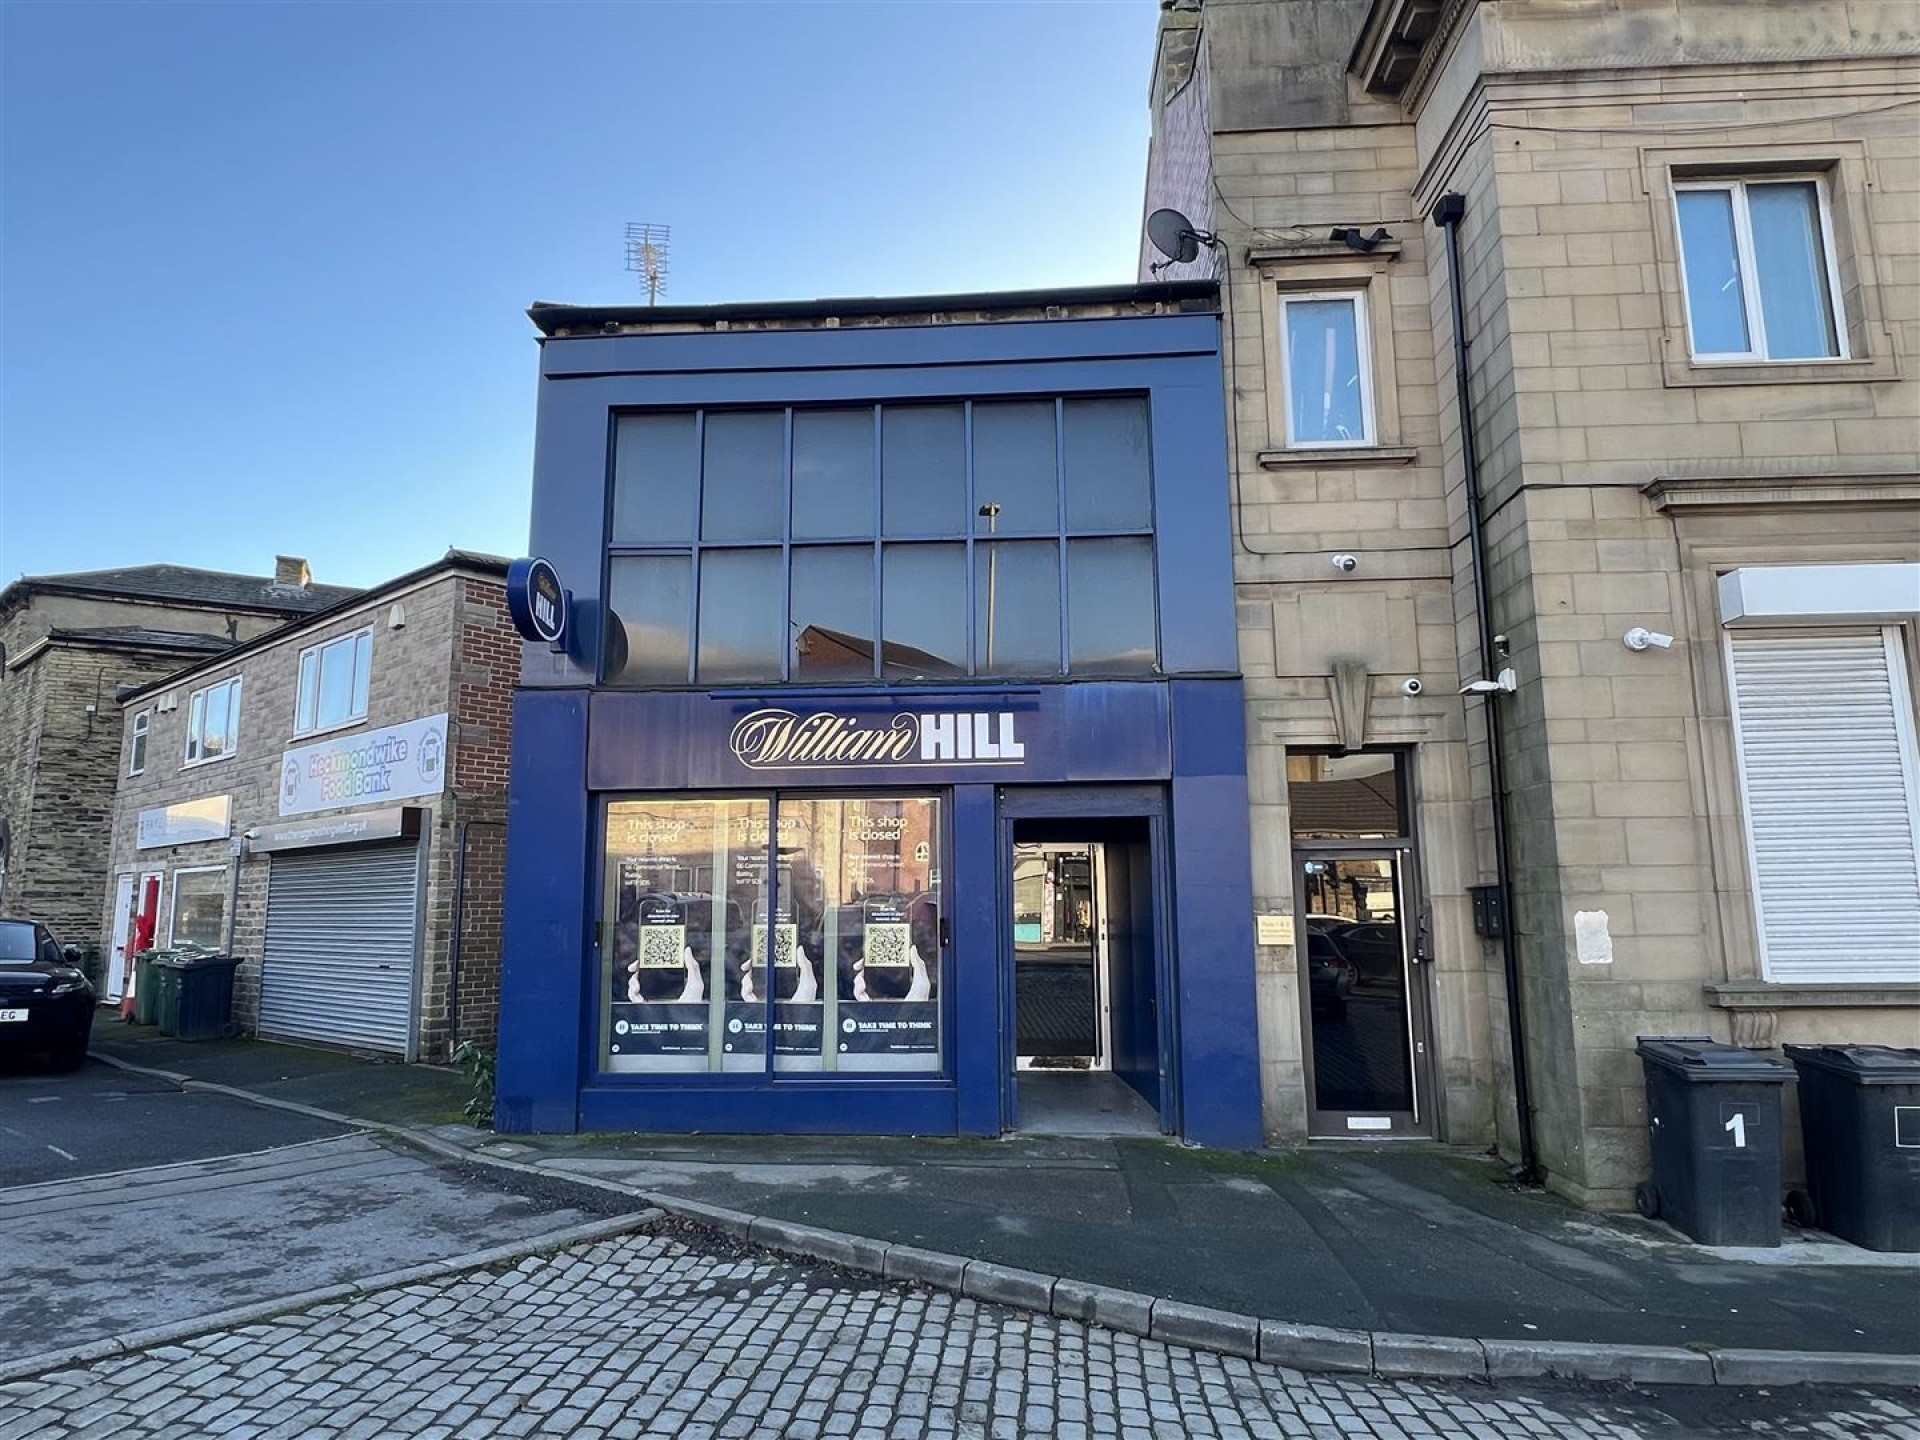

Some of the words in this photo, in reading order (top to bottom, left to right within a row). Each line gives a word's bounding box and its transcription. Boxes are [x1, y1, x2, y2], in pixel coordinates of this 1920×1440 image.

[535, 591, 556, 630] HILL
[730, 708, 920, 768] William
[921, 712, 1025, 760] HILL
[308, 736, 408, 778] Heckmondwike
[321, 771, 353, 801] Food
[355, 765, 392, 796] Bank
[627, 818, 655, 830] This
[657, 818, 685, 832] shop
[737, 817, 764, 829] This
[849, 815, 875, 828] This
[877, 815, 908, 829] shop
[627, 831, 637, 843] is
[640, 831, 678, 843] closed
[848, 828, 858, 841] is
[860, 828, 901, 841] closed
[631, 1023, 649, 1031] TAKE
[651, 1023, 668, 1031] TIME
[669, 1023, 679, 1031] TO
[680, 1023, 704, 1031] THINK
[783, 1023, 793, 1031] TO
[794, 1024, 817, 1032] THINK
[1725, 1113, 1746, 1148] 1
